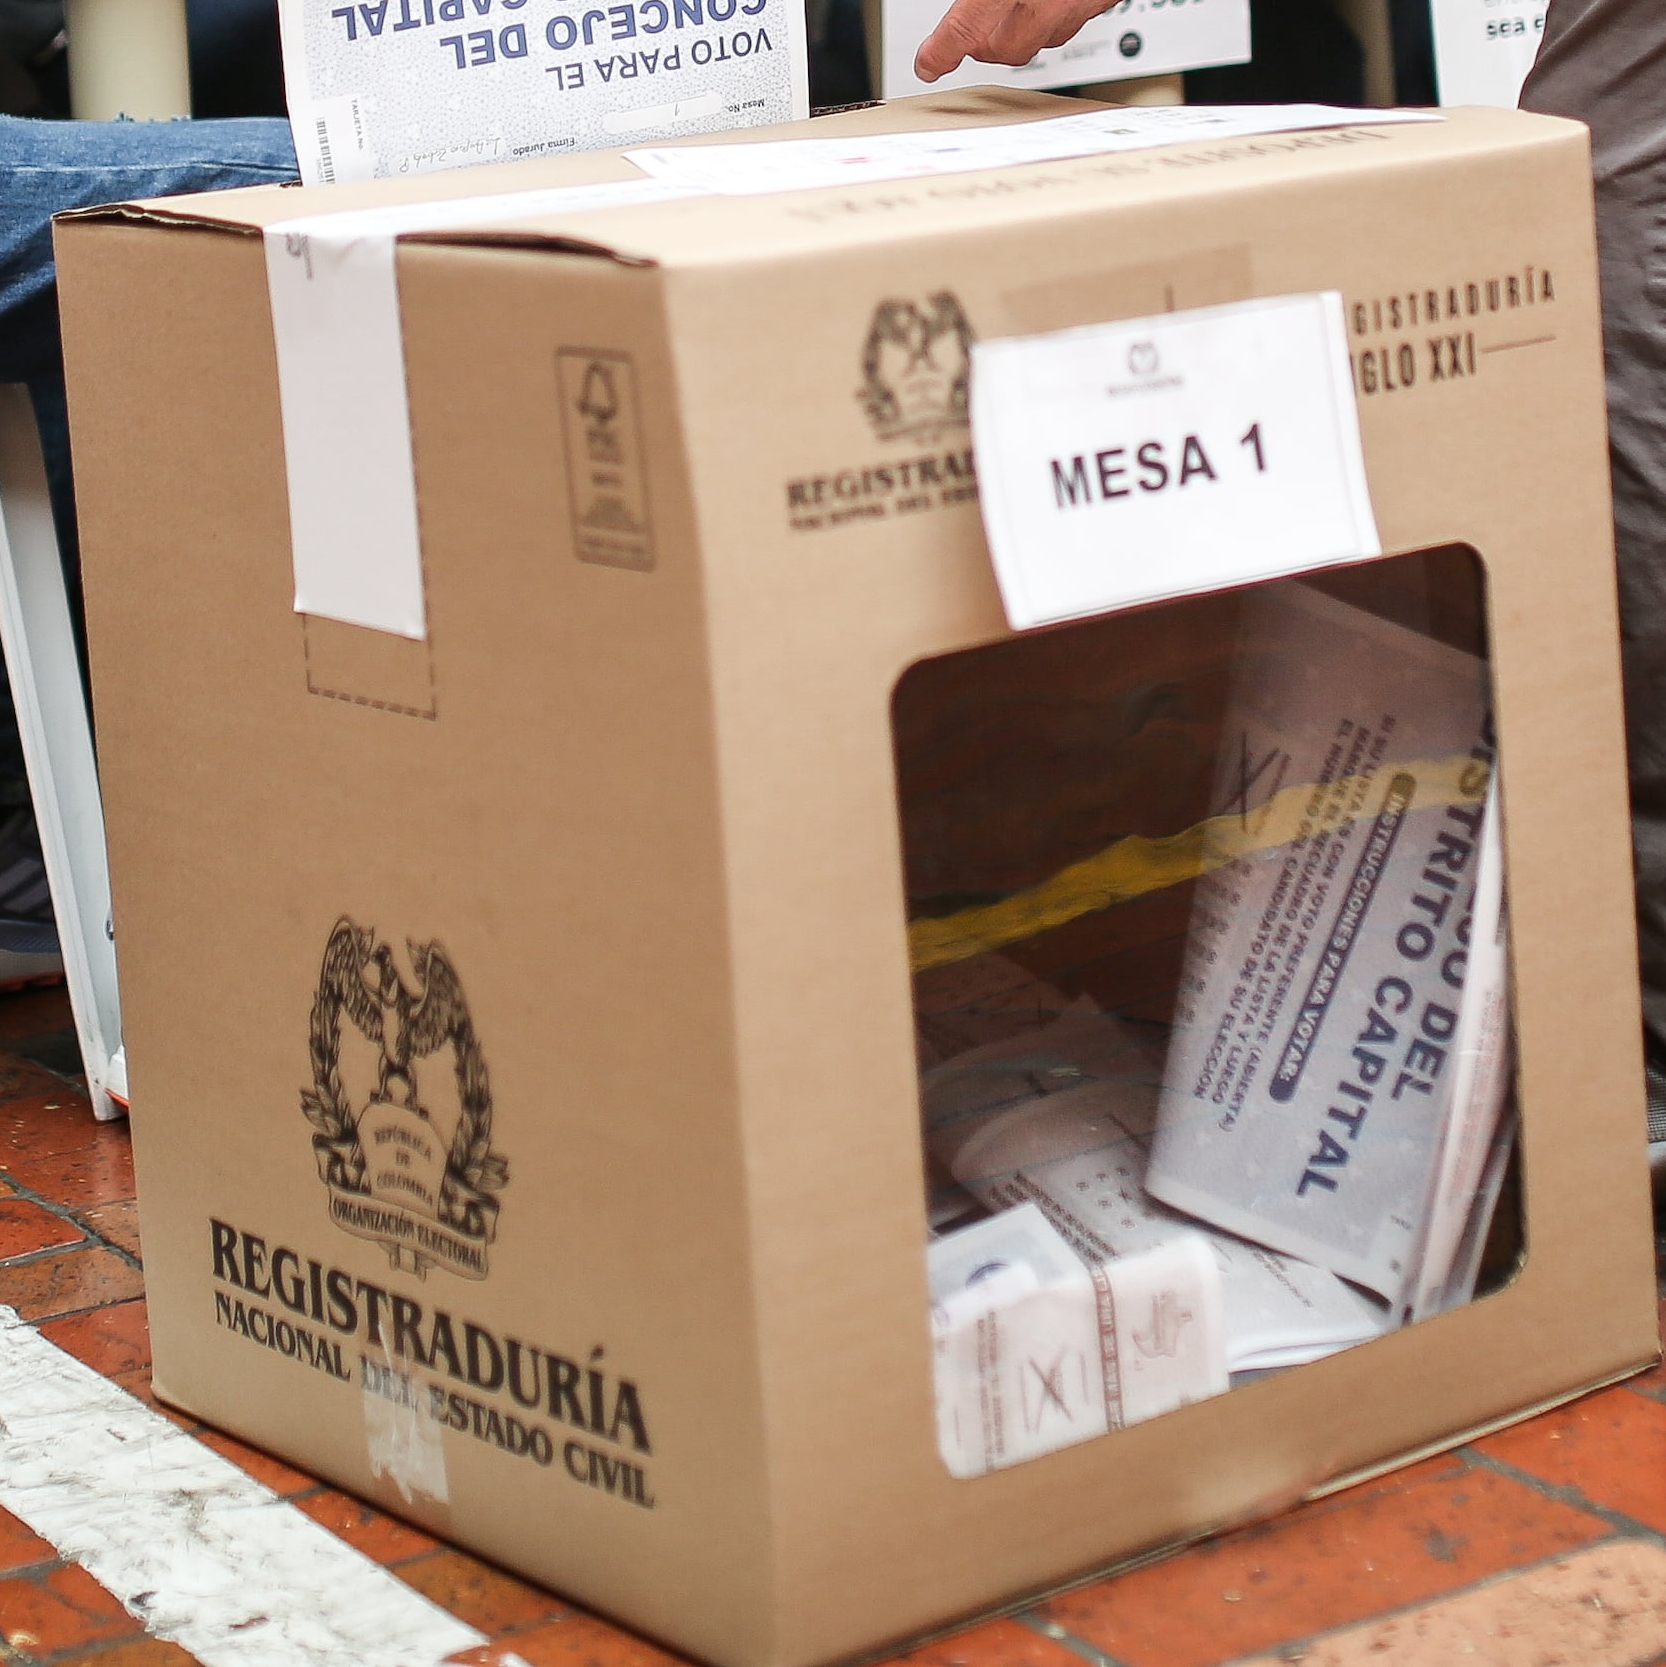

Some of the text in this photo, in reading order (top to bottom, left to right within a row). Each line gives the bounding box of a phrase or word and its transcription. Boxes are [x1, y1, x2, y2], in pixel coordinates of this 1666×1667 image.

[437, 22, 530, 72] DEL
[543, 26, 773, 93] VOTO PARA EL
[1486, 18, 1526, 37] sea
[349, 98, 363, 140] TARJETA
[741, 97, 765, 111] Mesa
[511, 136, 576, 156] Firma Jurado
[1352, 264, 1555, 335] GISTRADURÍA
[1349, 331, 1477, 396] GLO XXI
[1049, 434, 1217, 510] MESA
[1239, 421, 1267, 473] 1
[1298, 881, 1331, 933] VOTO
[1307, 950, 1344, 1008] PARA
[1276, 1008, 1321, 1084] VOTAR:
[1390, 1004, 1460, 1101] DEL
[1295, 976, 1415, 1200] CAPITAL
[209, 1218, 653, 1456] REGISTRADURÍA
[213, 1289, 655, 1510] NACIONAL DEL ESTADO CIVIL
